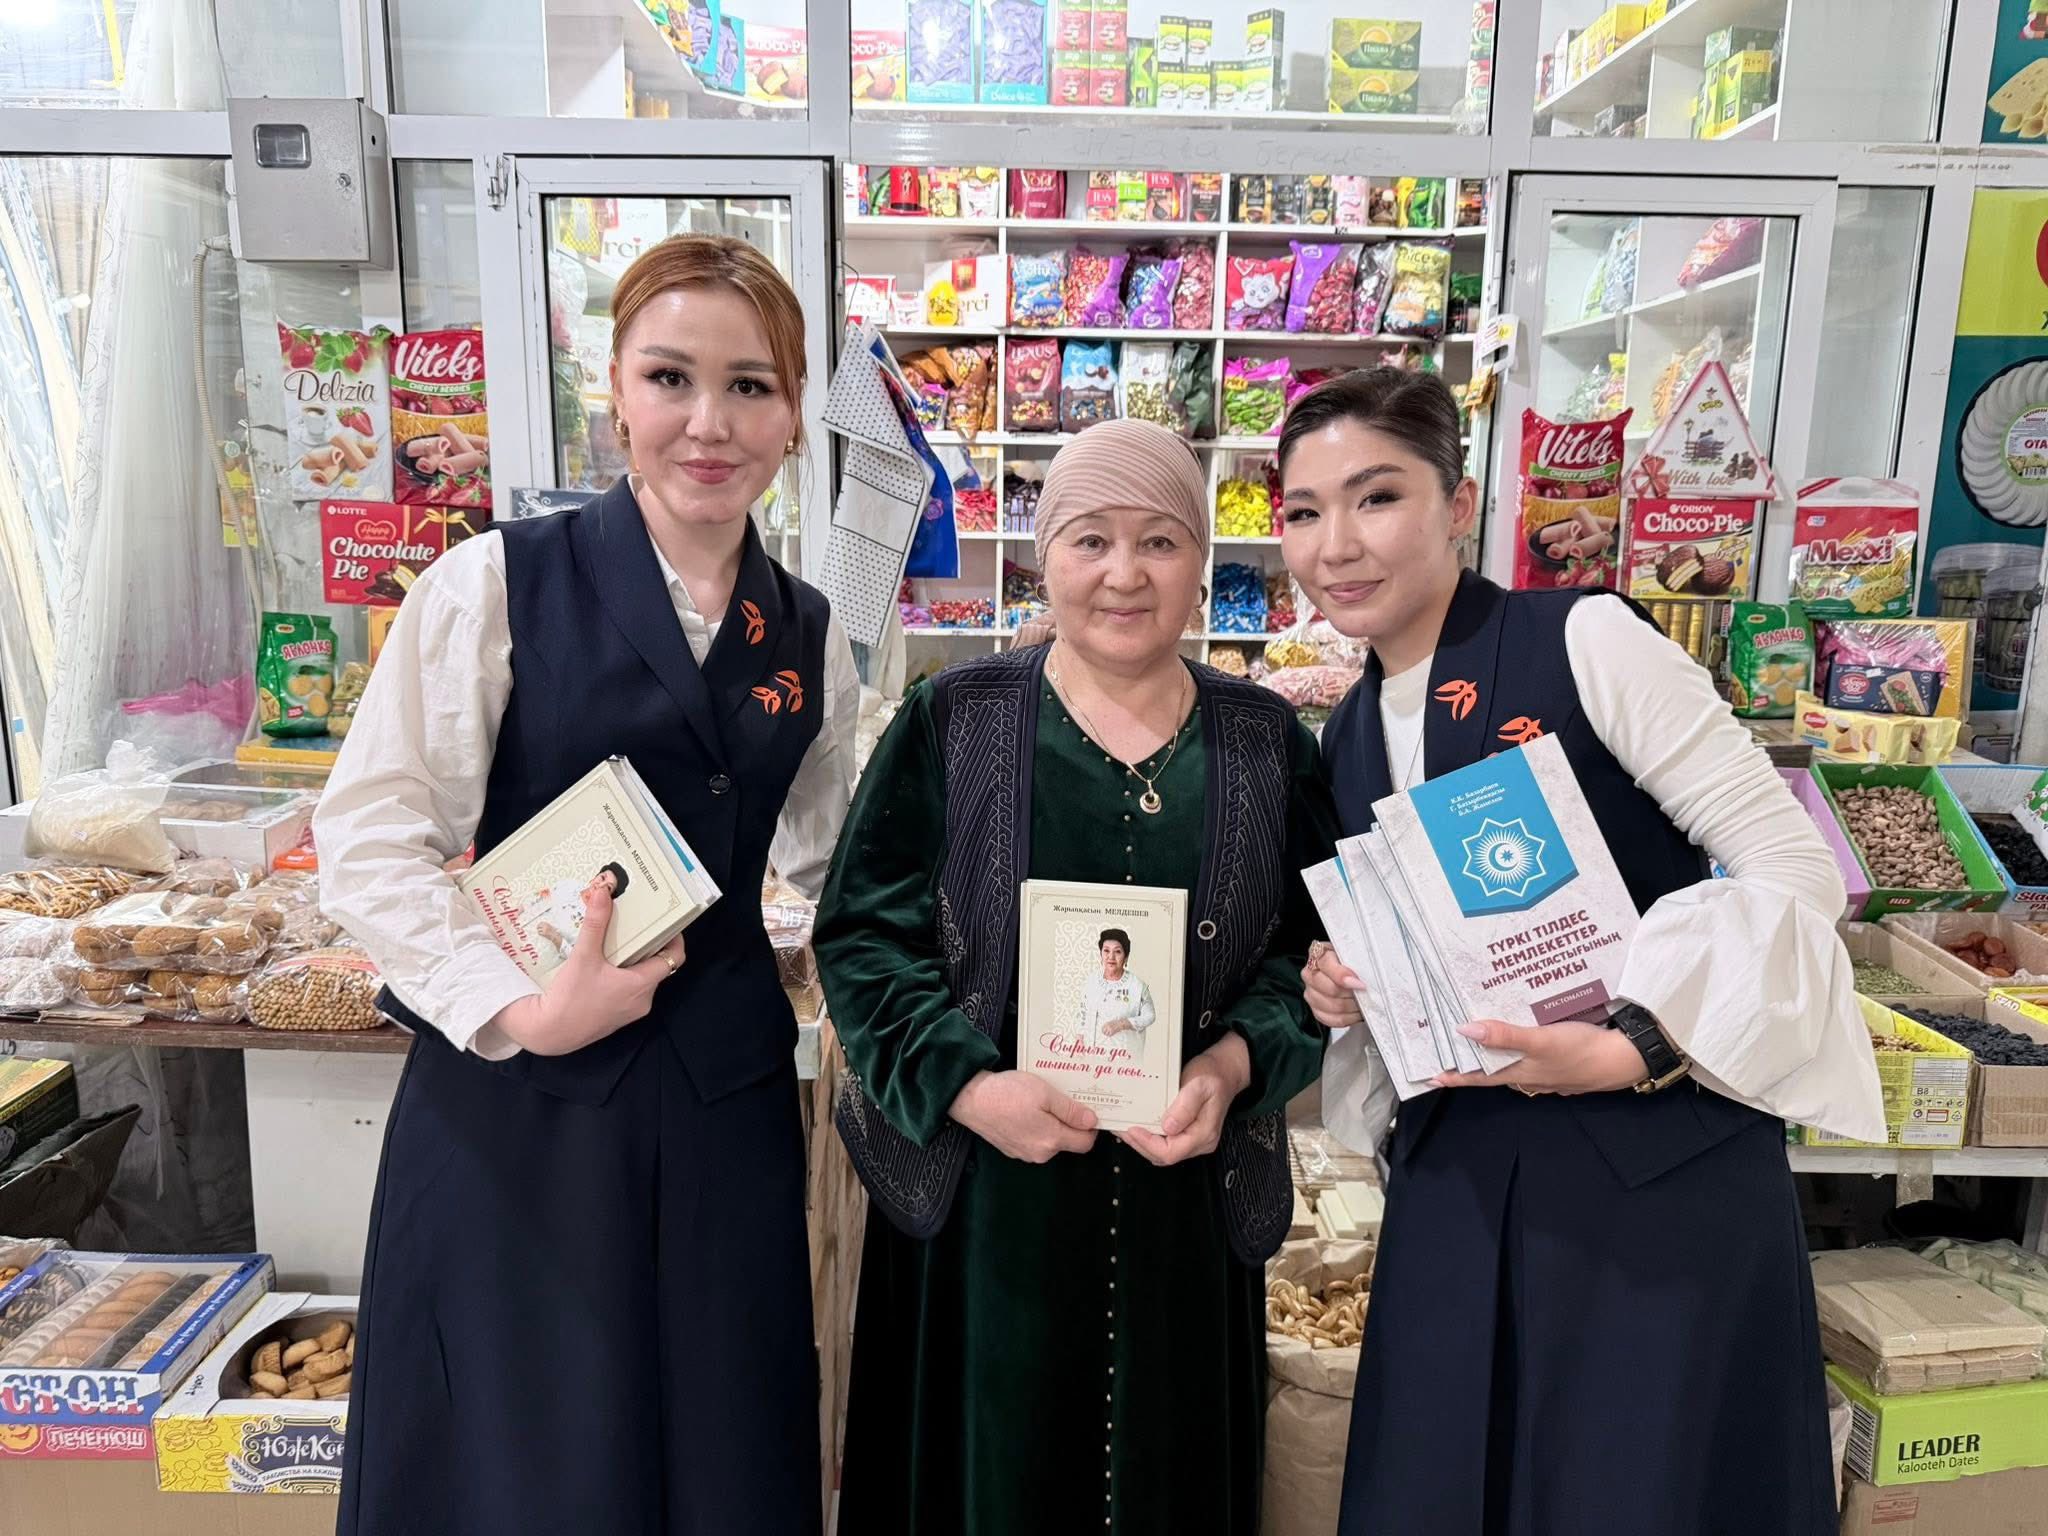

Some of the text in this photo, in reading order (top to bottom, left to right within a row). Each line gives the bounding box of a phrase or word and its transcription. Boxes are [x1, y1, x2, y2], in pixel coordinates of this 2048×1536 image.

[395, 337, 482, 381] Viteks
[283, 369, 377, 402] Delizia
[1538, 424, 1614, 468] Viteks
[1670, 468, 1701, 486] With
[336, 507, 367, 515] LOTTE
[329, 536, 436, 561] Chocolate
[1809, 537, 1894, 564] Mexxi
[331, 559, 369, 580] Pie
[1487, 909, 1590, 955] ТҮРКІ ТІЛДЕС
[1491, 924, 1598, 972] МЕМЛЕКЕТТЕР
[1525, 958, 1588, 990] ТАРИХЫ
[1543, 987, 1594, 1010] ХРЕСТОМАТИЯ
[1898, 1433, 1980, 1462] LEADER
[1897, 1455, 1980, 1475] Kalooteh Dates
